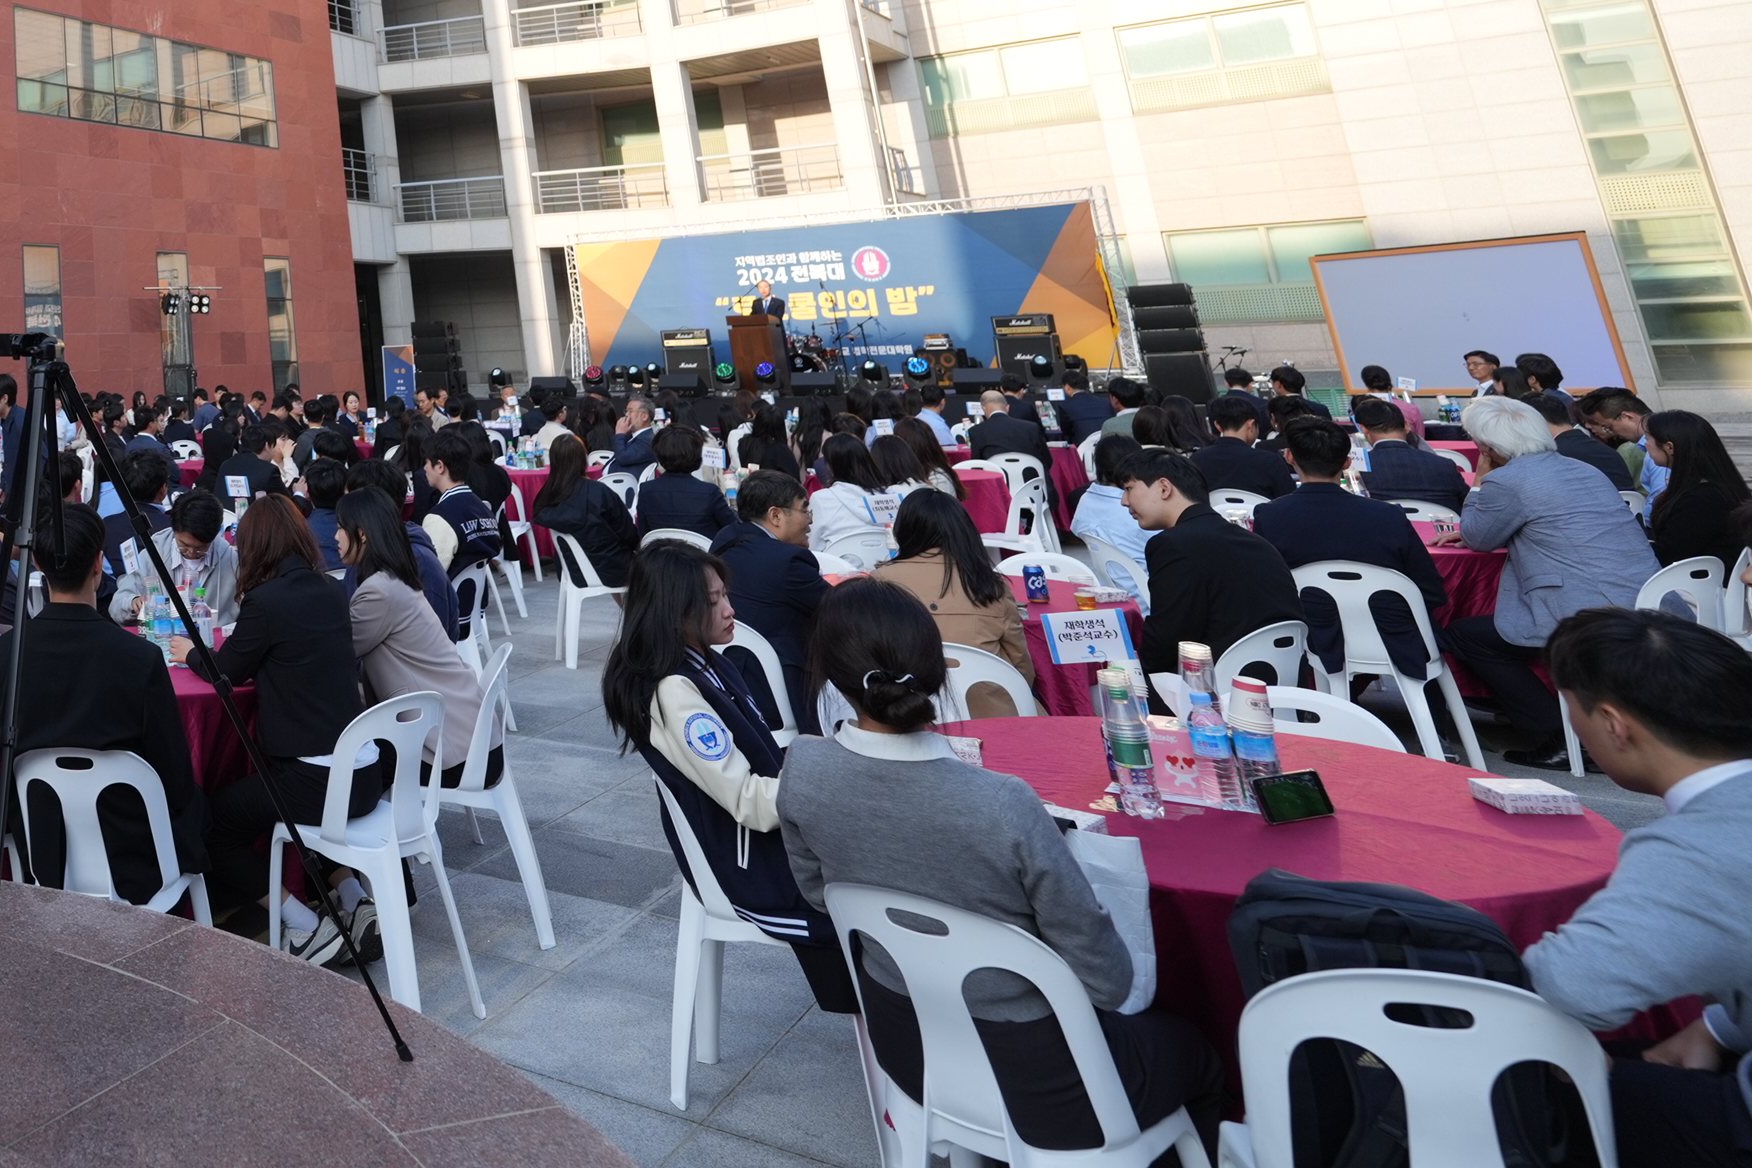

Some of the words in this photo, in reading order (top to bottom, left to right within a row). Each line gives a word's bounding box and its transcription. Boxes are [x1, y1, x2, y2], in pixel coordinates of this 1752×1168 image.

[734, 253, 797, 267] 지역법조인과
[798, 250, 843, 264] 함께하는
[736, 266, 789, 286] 2024
[790, 262, 846, 283] 전북대
[715, 289, 880, 321] “로쿨인의
[885, 285, 935, 316] 밤”
[1064, 618, 1106, 630] 재학생석
[1058, 629, 1118, 643] (박준석교수)
